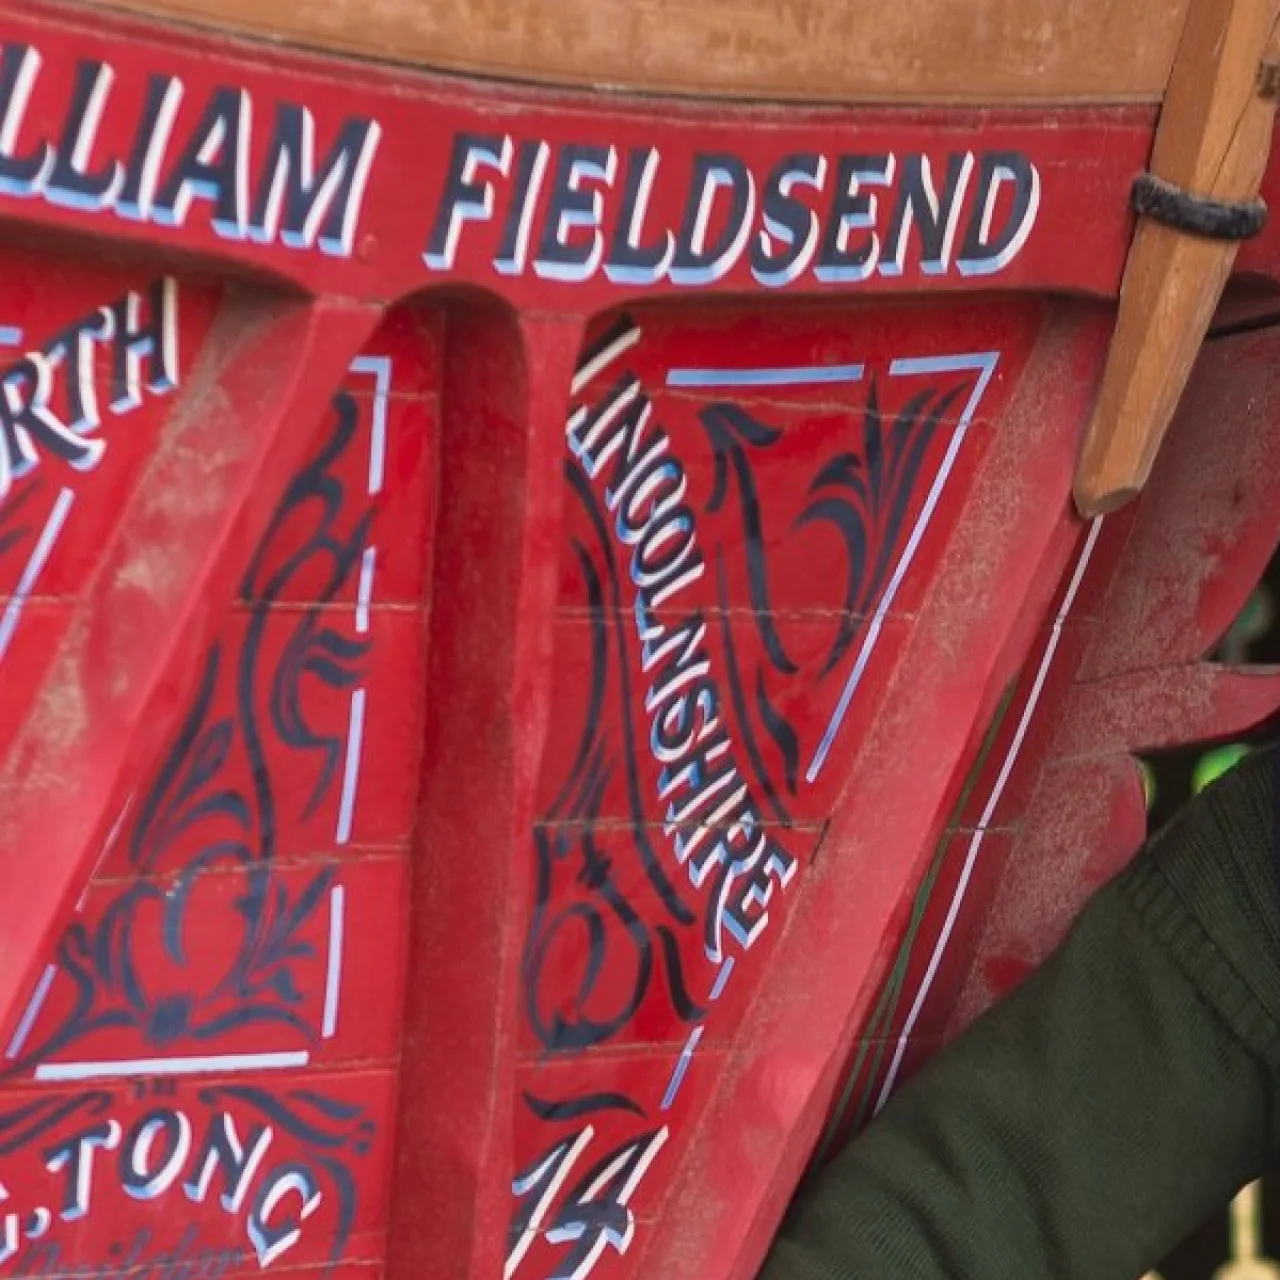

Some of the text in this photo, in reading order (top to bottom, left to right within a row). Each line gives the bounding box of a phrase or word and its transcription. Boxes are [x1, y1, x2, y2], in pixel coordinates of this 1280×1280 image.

[422, 132, 1040, 287] FIELDSEND
[0, 275, 180, 497] RTH
[565, 312, 798, 963] LINCOLNSHIRE
